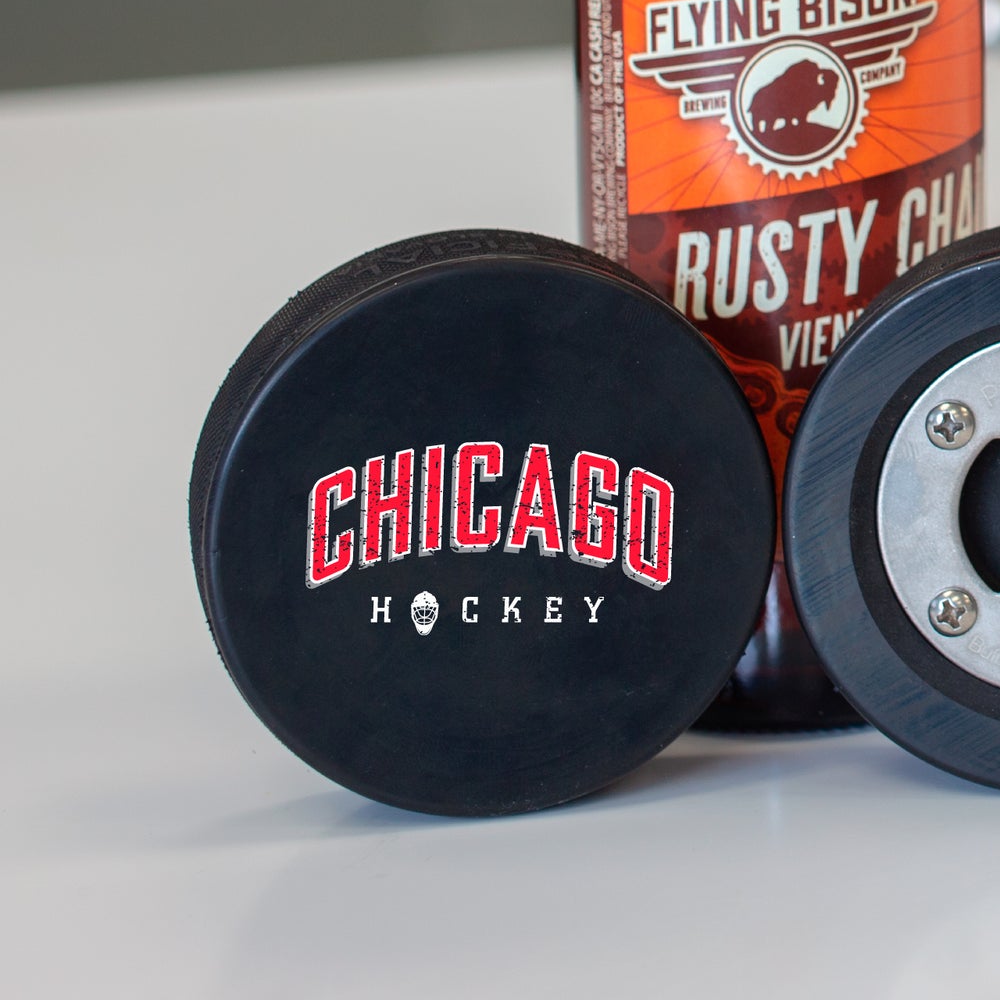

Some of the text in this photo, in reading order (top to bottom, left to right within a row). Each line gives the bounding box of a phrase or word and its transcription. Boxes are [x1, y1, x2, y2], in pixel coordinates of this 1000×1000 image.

[684, 63, 902, 113] BREWING COMPANY
[674, 199, 879, 321] RUSTY
[779, 309, 864, 371] VIEN
[305, 441, 675, 591] CHICAGO
